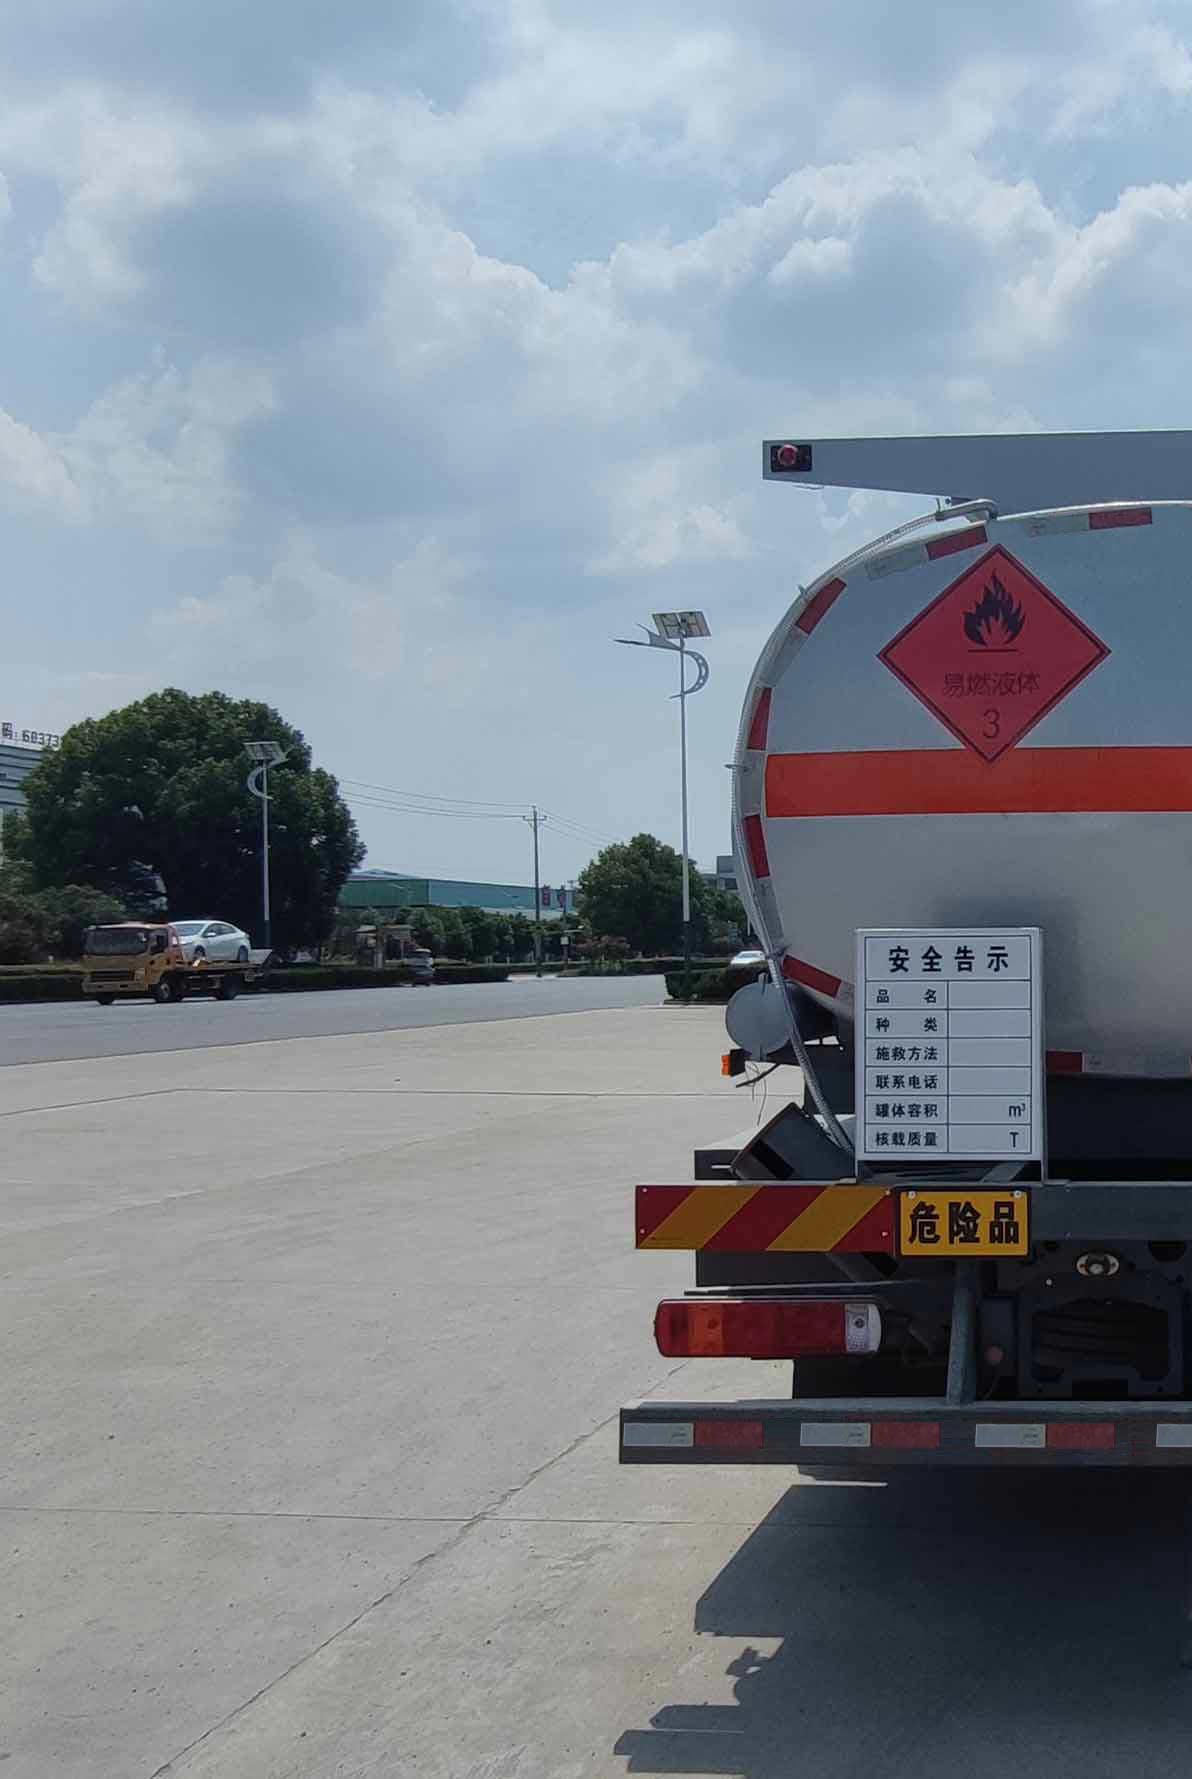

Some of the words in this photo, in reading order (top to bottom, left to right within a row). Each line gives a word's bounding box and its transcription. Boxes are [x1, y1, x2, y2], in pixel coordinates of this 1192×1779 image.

[944, 672, 1040, 698] 易燃液体
[983, 708, 1000, 739] 3
[888, 946, 1009, 972] 安全告示
[876, 989, 937, 1004] 品名
[875, 1017, 938, 1032] 种类
[876, 1047, 938, 1061] 施救方法
[876, 1075, 938, 1089] 联系电话
[875, 1104, 938, 1118] 罐体容积
[875, 1132, 937, 1146] 核载质量
[1010, 1132, 1019, 1148] T
[908, 1201, 1020, 1244] 危险品
